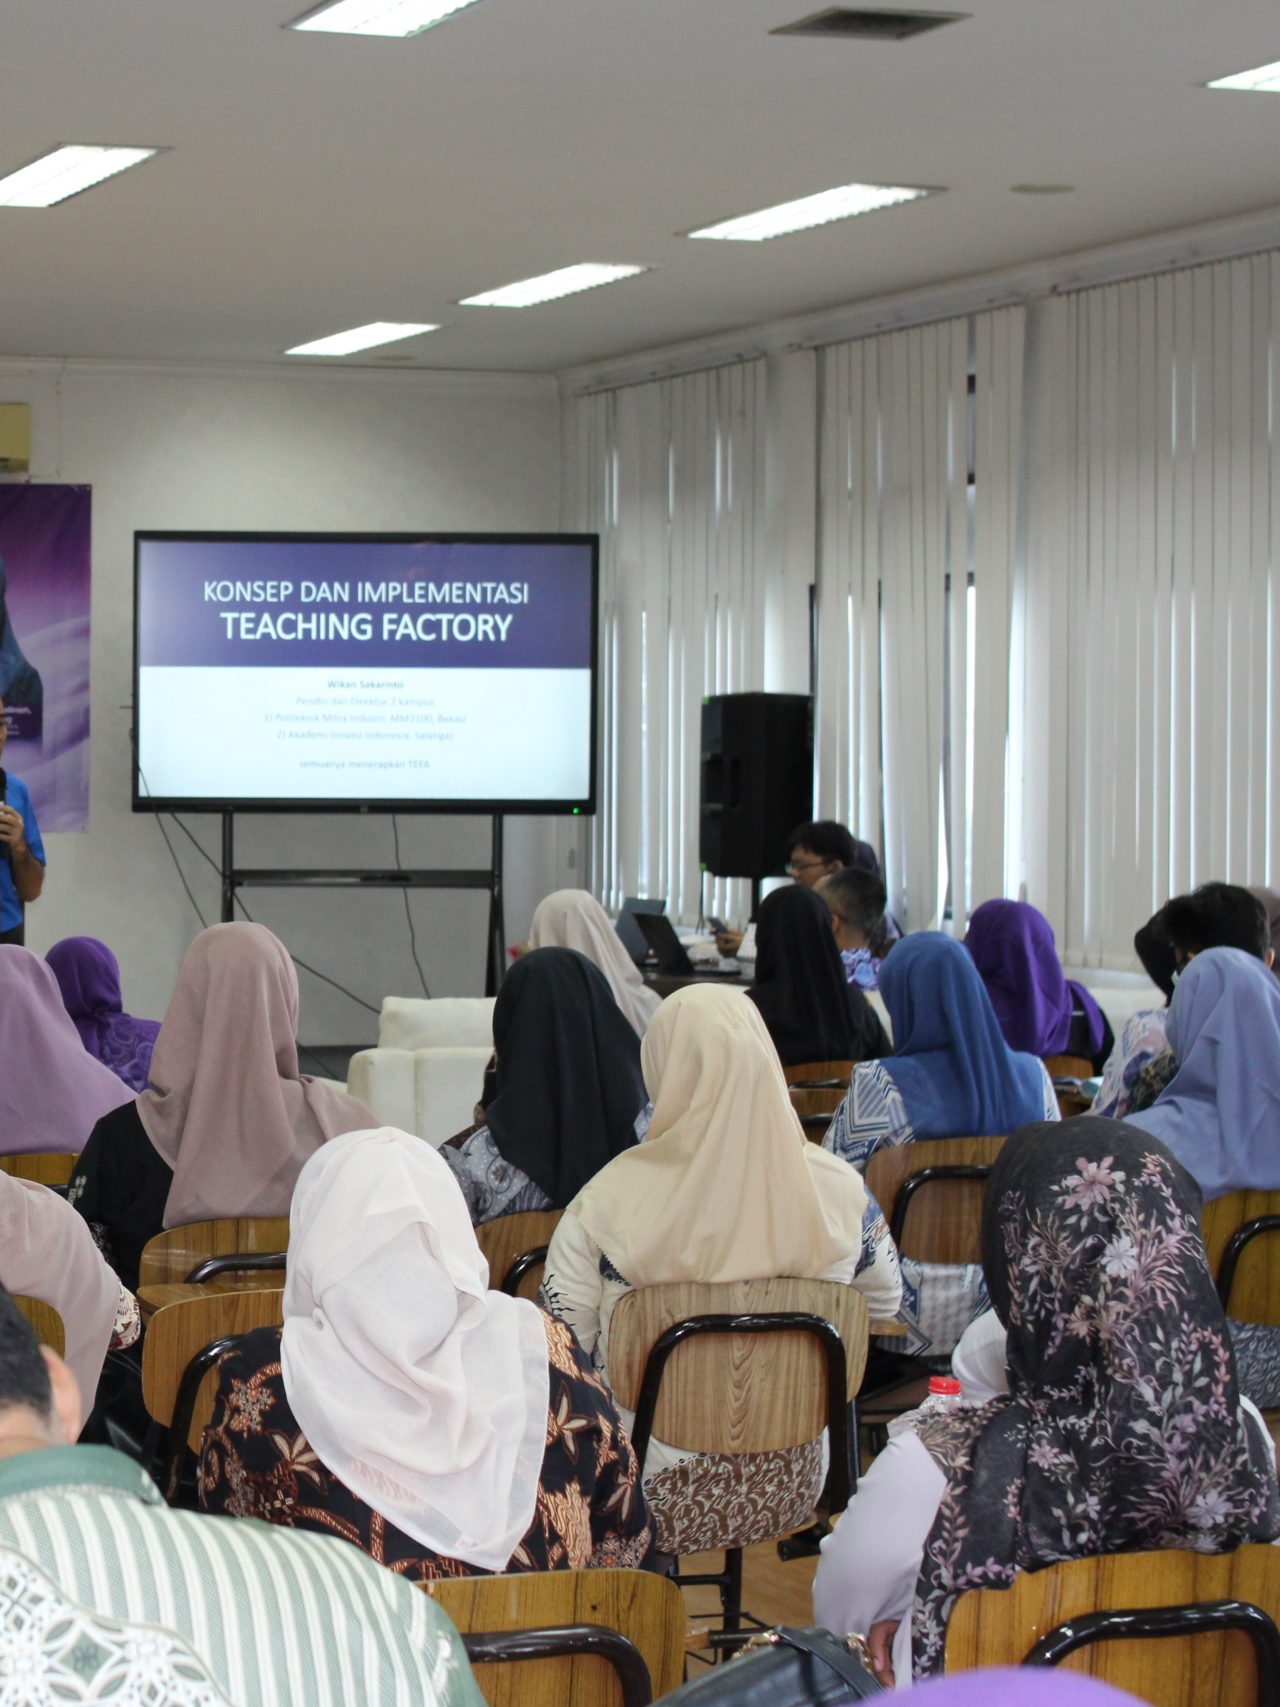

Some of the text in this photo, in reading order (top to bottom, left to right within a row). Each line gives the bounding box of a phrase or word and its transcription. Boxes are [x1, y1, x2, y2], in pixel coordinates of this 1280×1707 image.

[204, 581, 529, 604] KONSEP DAN IMPLEMENTASI
[220, 612, 513, 641] TEACHING FACTORY
[327, 679, 404, 690] Wikan Sakarinto
